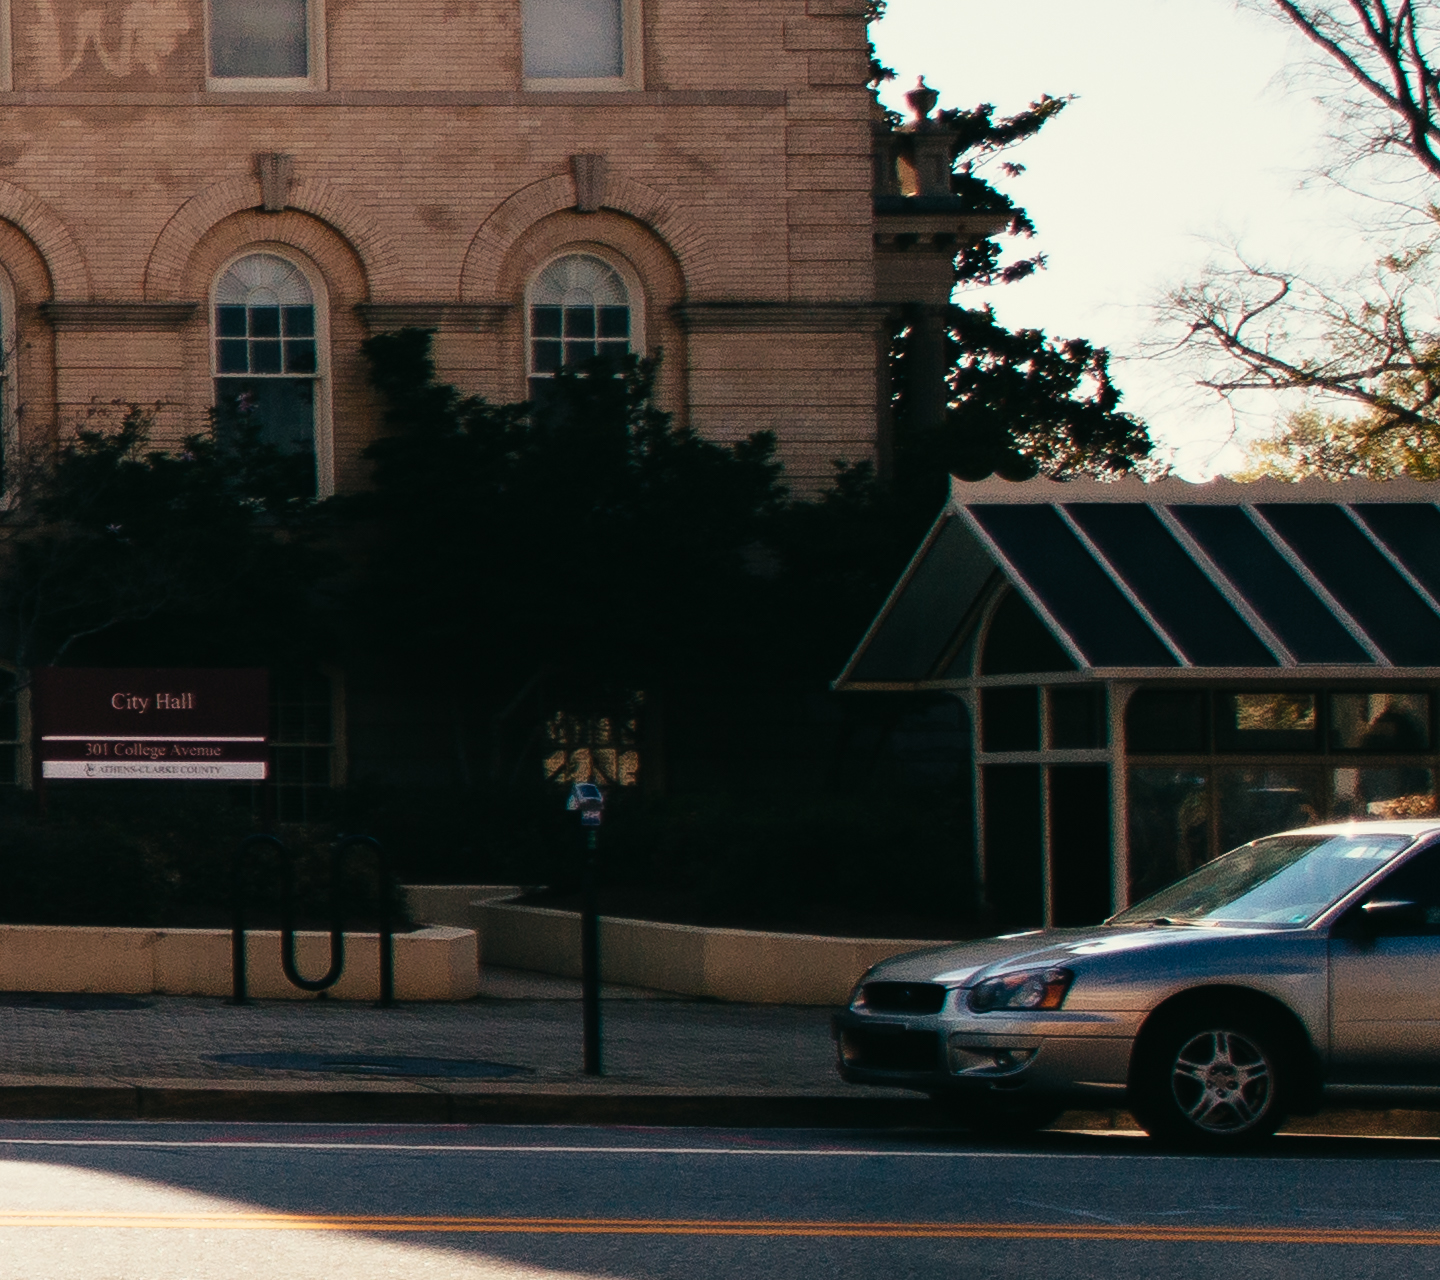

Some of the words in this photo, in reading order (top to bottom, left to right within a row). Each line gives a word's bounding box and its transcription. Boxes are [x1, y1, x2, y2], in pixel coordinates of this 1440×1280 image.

[111, 692, 149, 714] City
[155, 692, 194, 710] Hall
[85, 743, 108, 756] 301
[113, 743, 166, 760] College
[170, 744, 222, 756] Avenue
[99, 765, 180, 775] ATHENS-CLARKE
[180, 765, 222, 775] COUNTY
